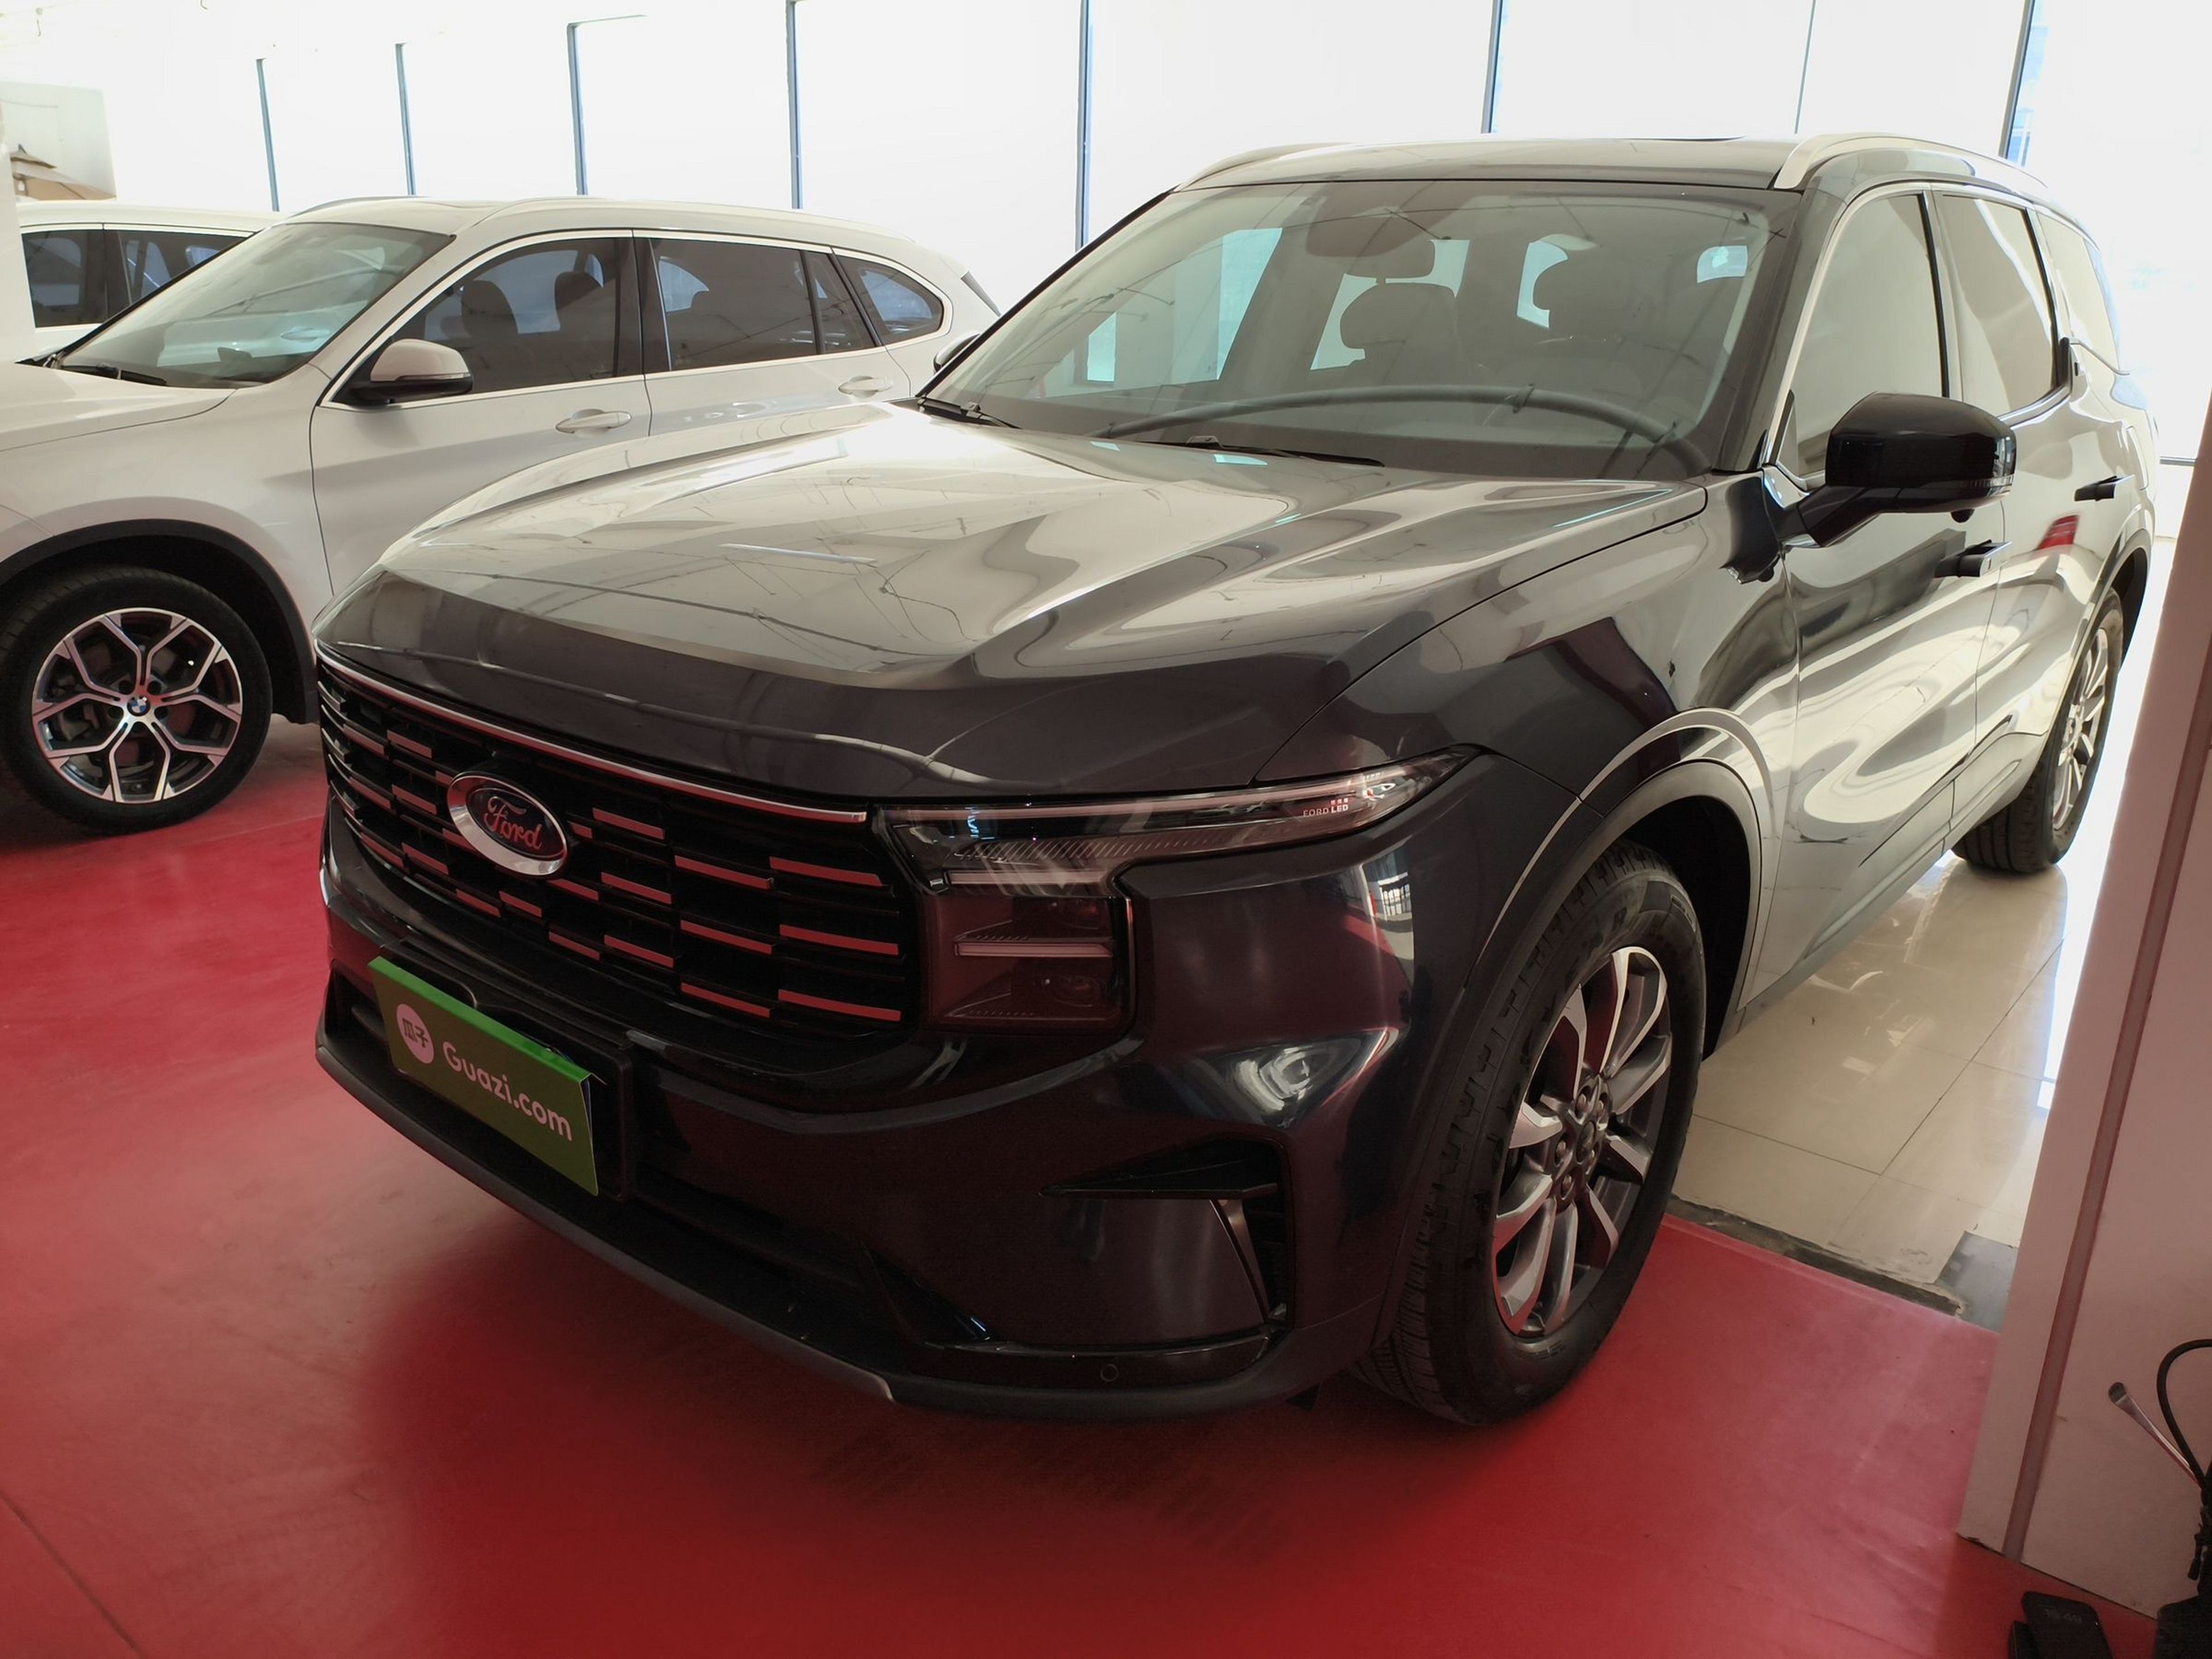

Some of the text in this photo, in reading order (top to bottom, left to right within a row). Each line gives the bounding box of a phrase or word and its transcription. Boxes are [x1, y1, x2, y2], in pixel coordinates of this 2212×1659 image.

[484, 796, 543, 850] Ford
[1303, 804, 1349, 817] FORD LED
[442, 1041, 573, 1142] Guazi.com
